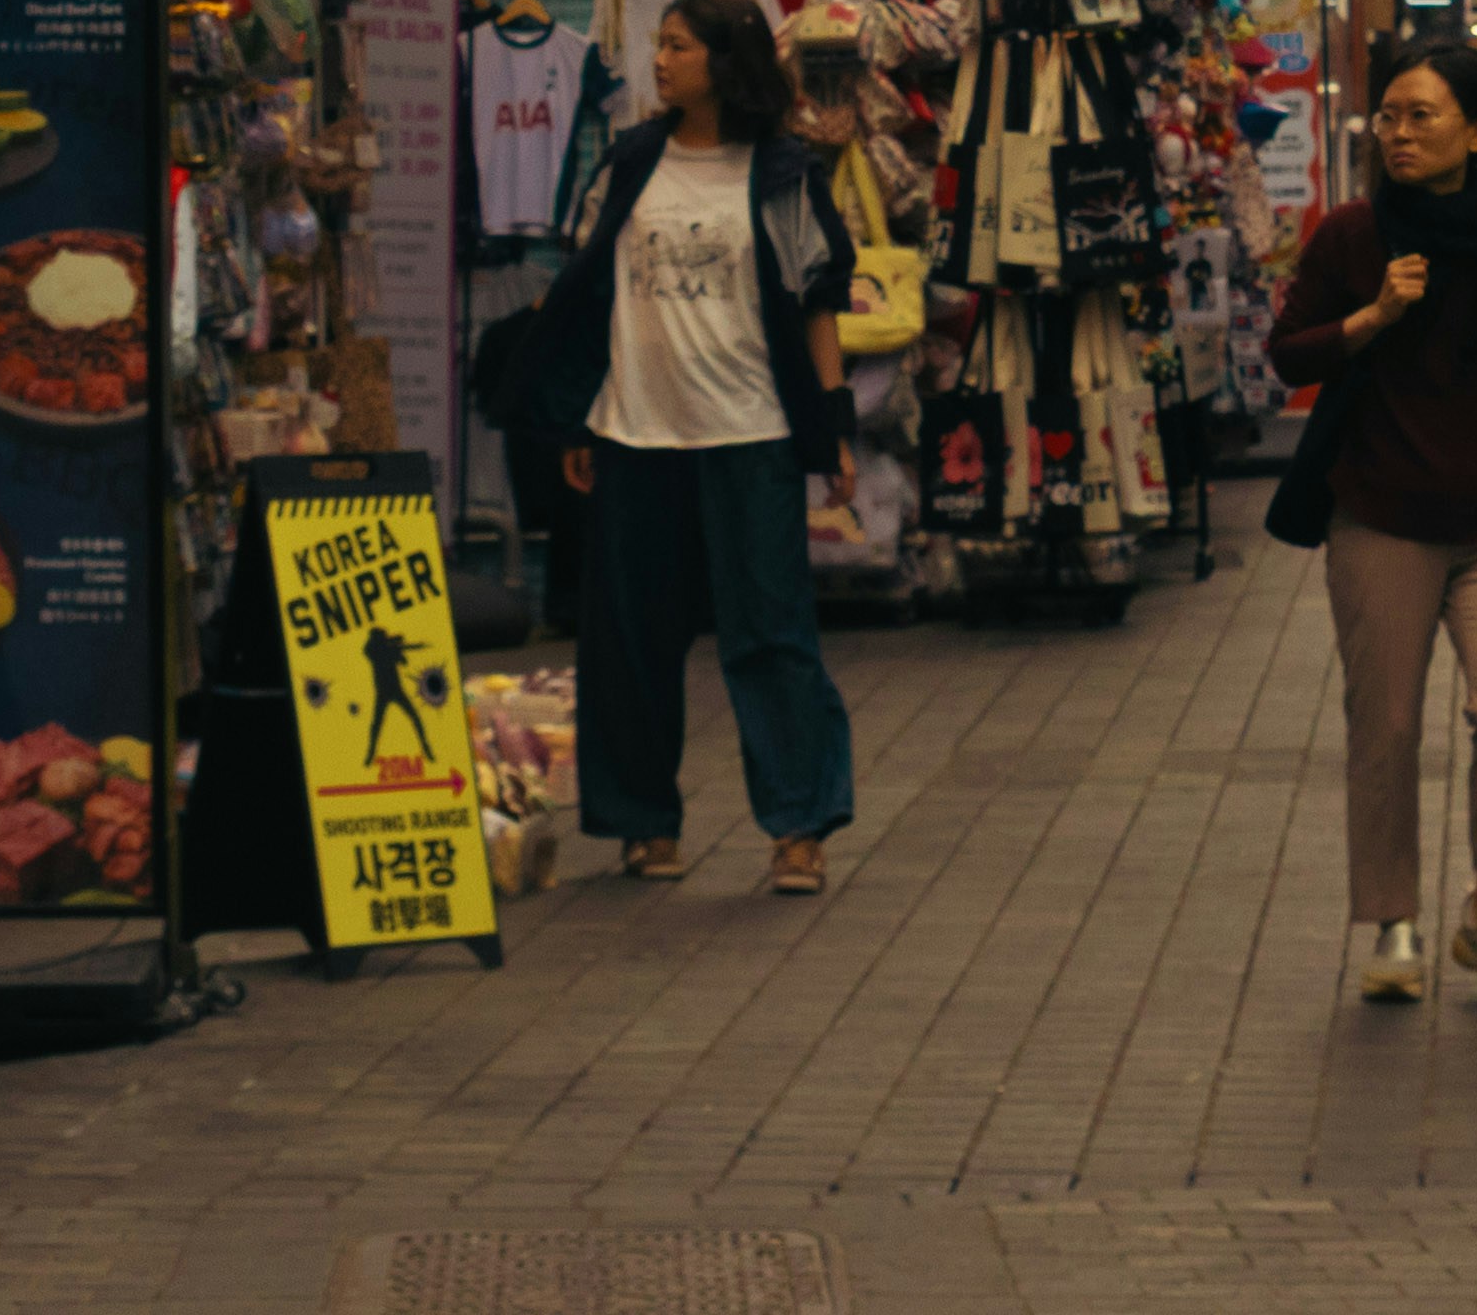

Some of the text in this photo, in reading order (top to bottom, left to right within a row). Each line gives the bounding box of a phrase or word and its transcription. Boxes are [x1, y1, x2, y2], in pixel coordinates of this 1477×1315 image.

[292, 520, 400, 588] KOREA
[286, 551, 441, 649] SNIPER
[323, 807, 471, 839] SHOOTING RANGE
[352, 838, 457, 893] 사격장
